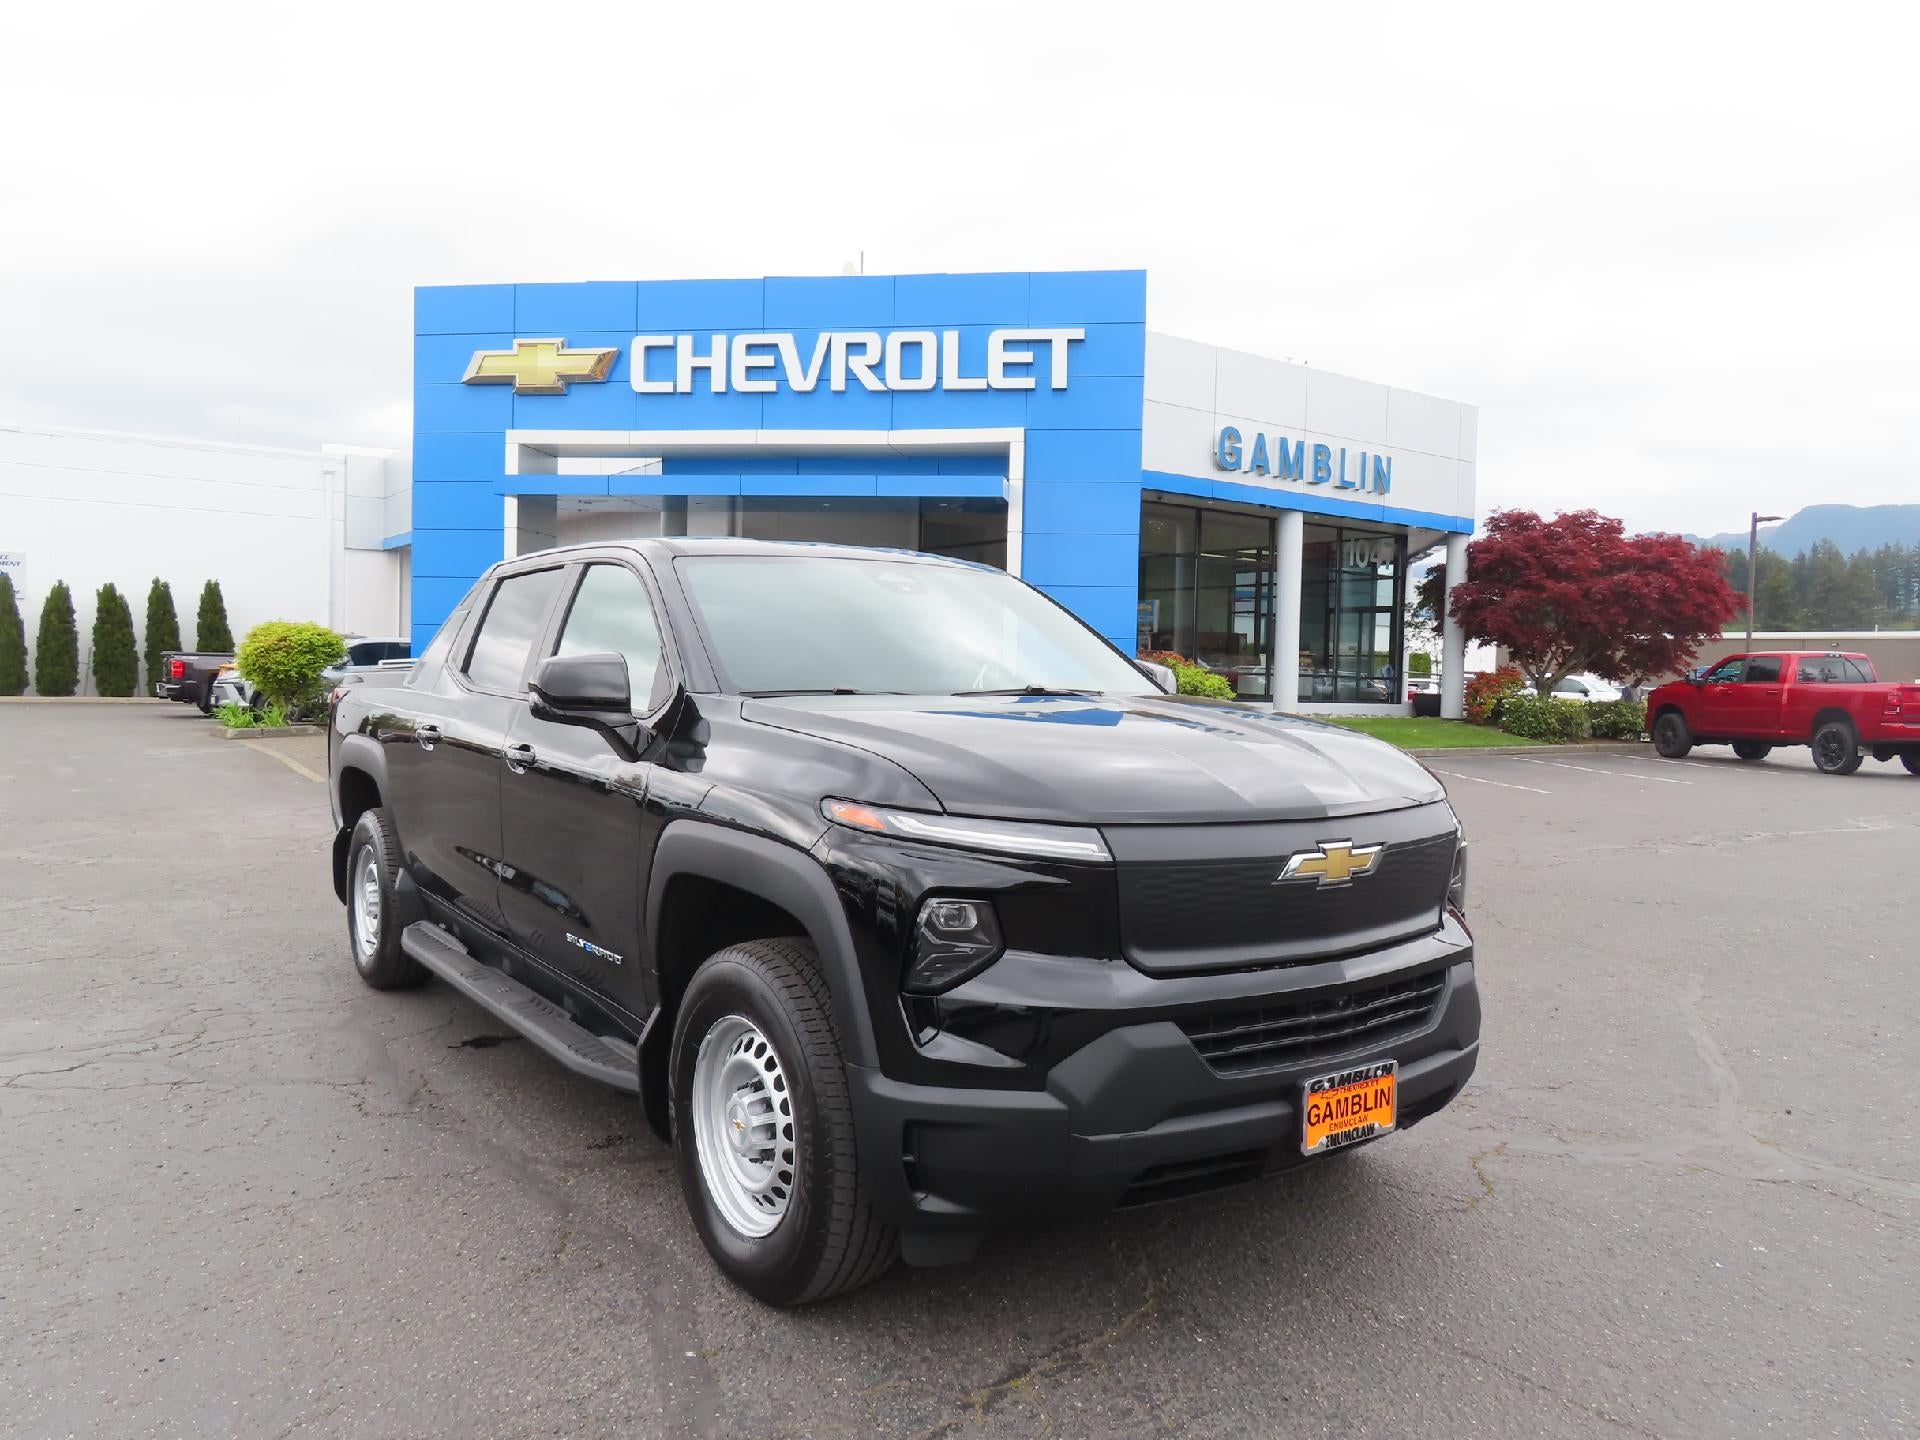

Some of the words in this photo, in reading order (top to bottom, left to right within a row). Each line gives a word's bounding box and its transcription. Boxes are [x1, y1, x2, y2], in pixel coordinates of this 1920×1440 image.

[630, 328, 1086, 393] CHEVROLET
[1215, 426, 1392, 494] GAMBLIN
[565, 932, 624, 965] SILVERADO
[1310, 1062, 1394, 1093] GAMBLIN
[1307, 1086, 1391, 1127] GAMBLIN
[1329, 1114, 1368, 1131] ENUMCLAW
[1325, 1123, 1375, 1148] ENUMCLAW
